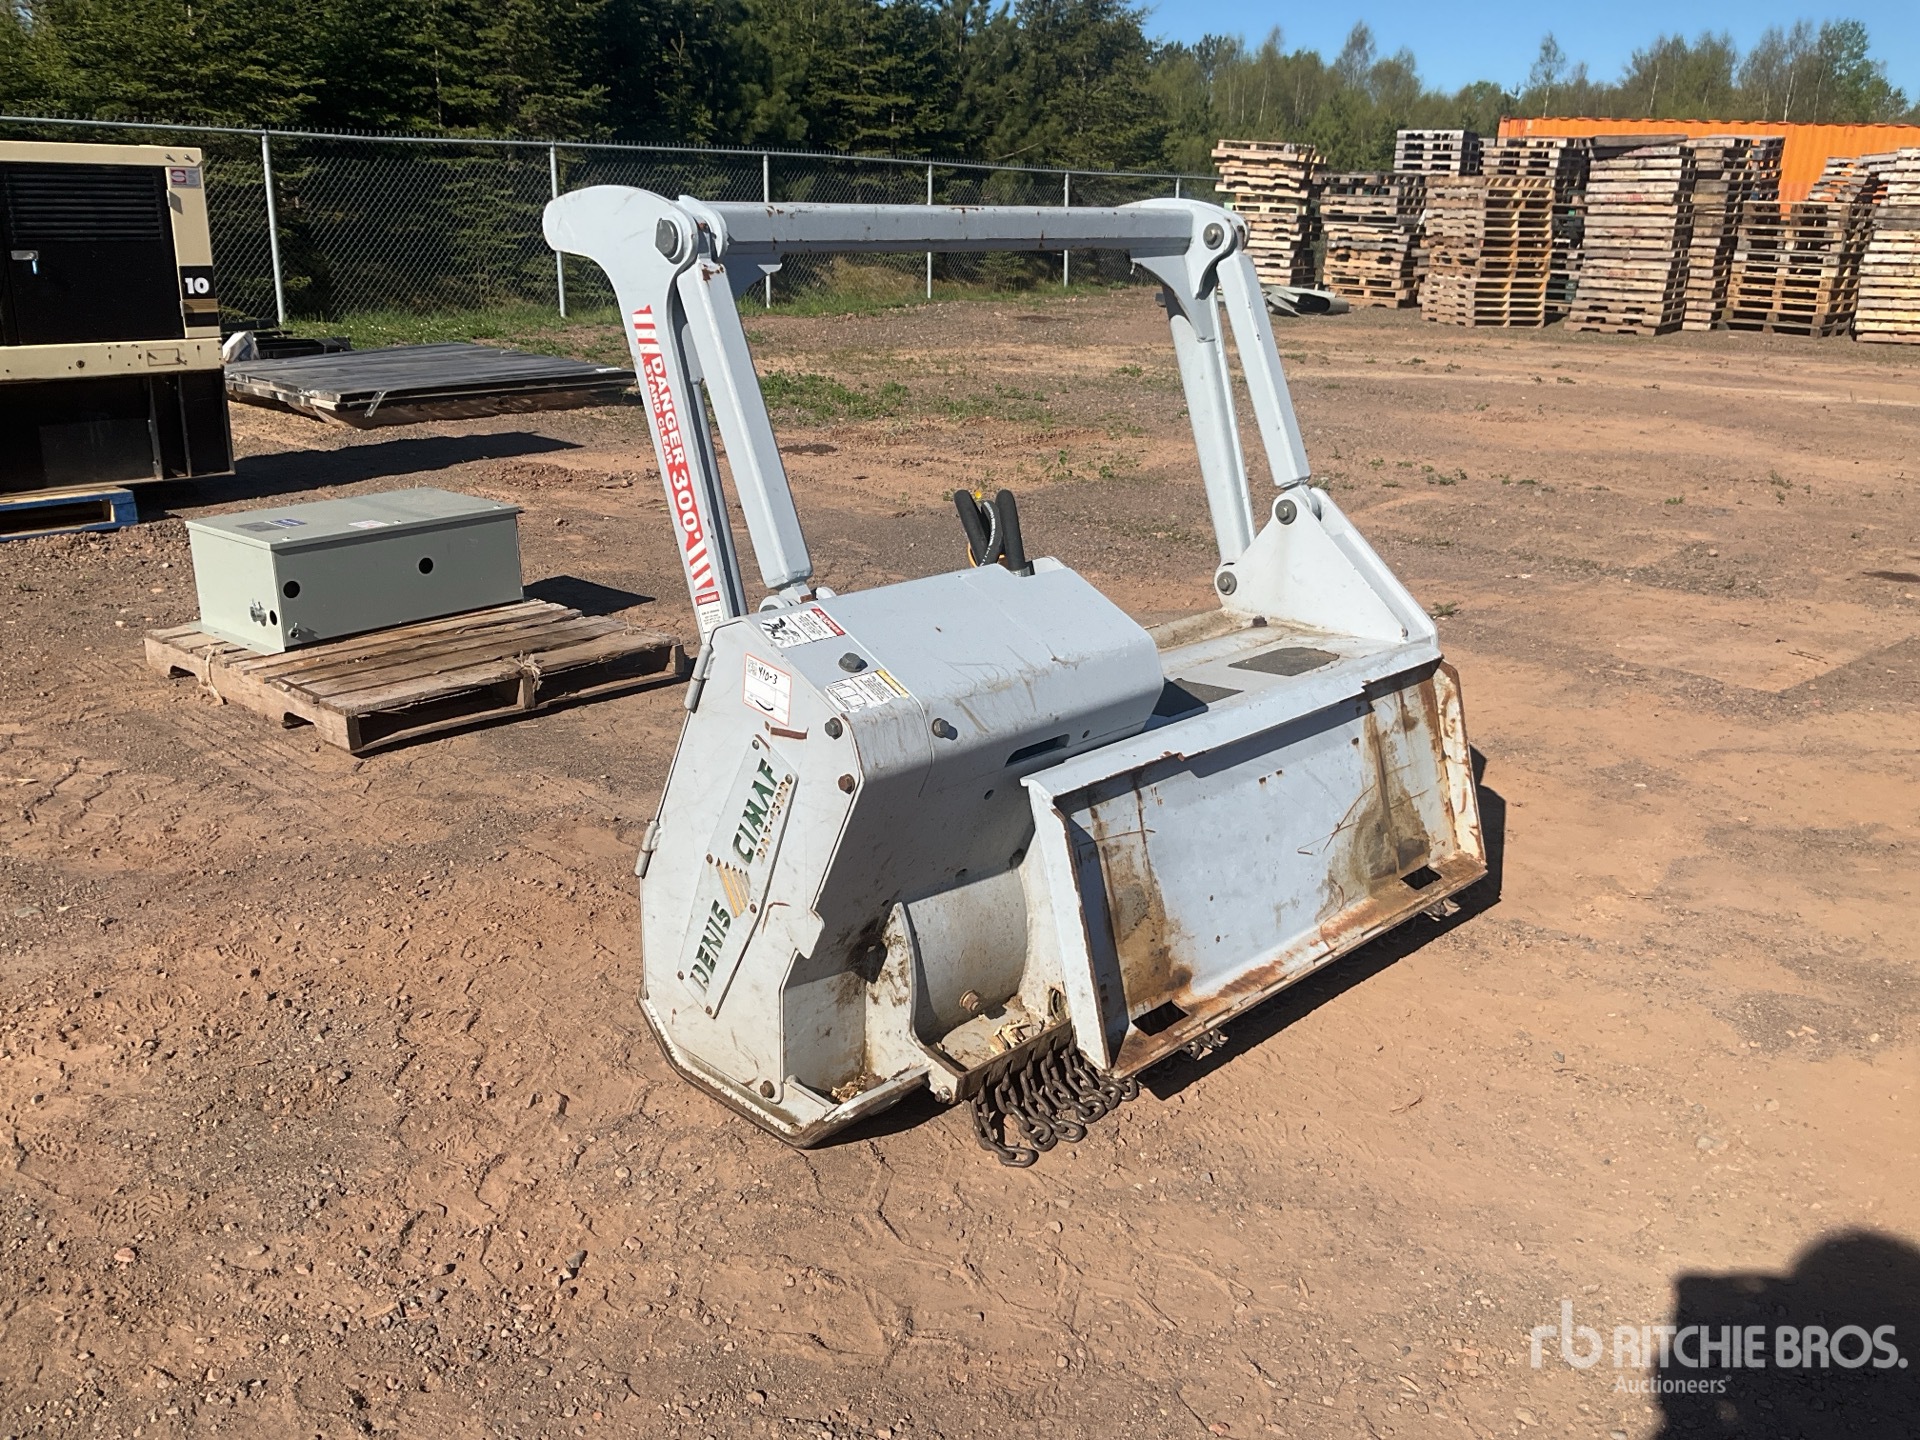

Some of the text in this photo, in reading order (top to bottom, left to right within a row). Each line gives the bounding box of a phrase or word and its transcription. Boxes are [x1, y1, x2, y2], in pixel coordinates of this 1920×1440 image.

[185, 277, 210, 294] 10
[645, 364, 673, 465] STAND CLEAR
[651, 356, 685, 466] DANGER
[689, 899, 731, 996] DENIS
[732, 758, 778, 866] CIMAF
